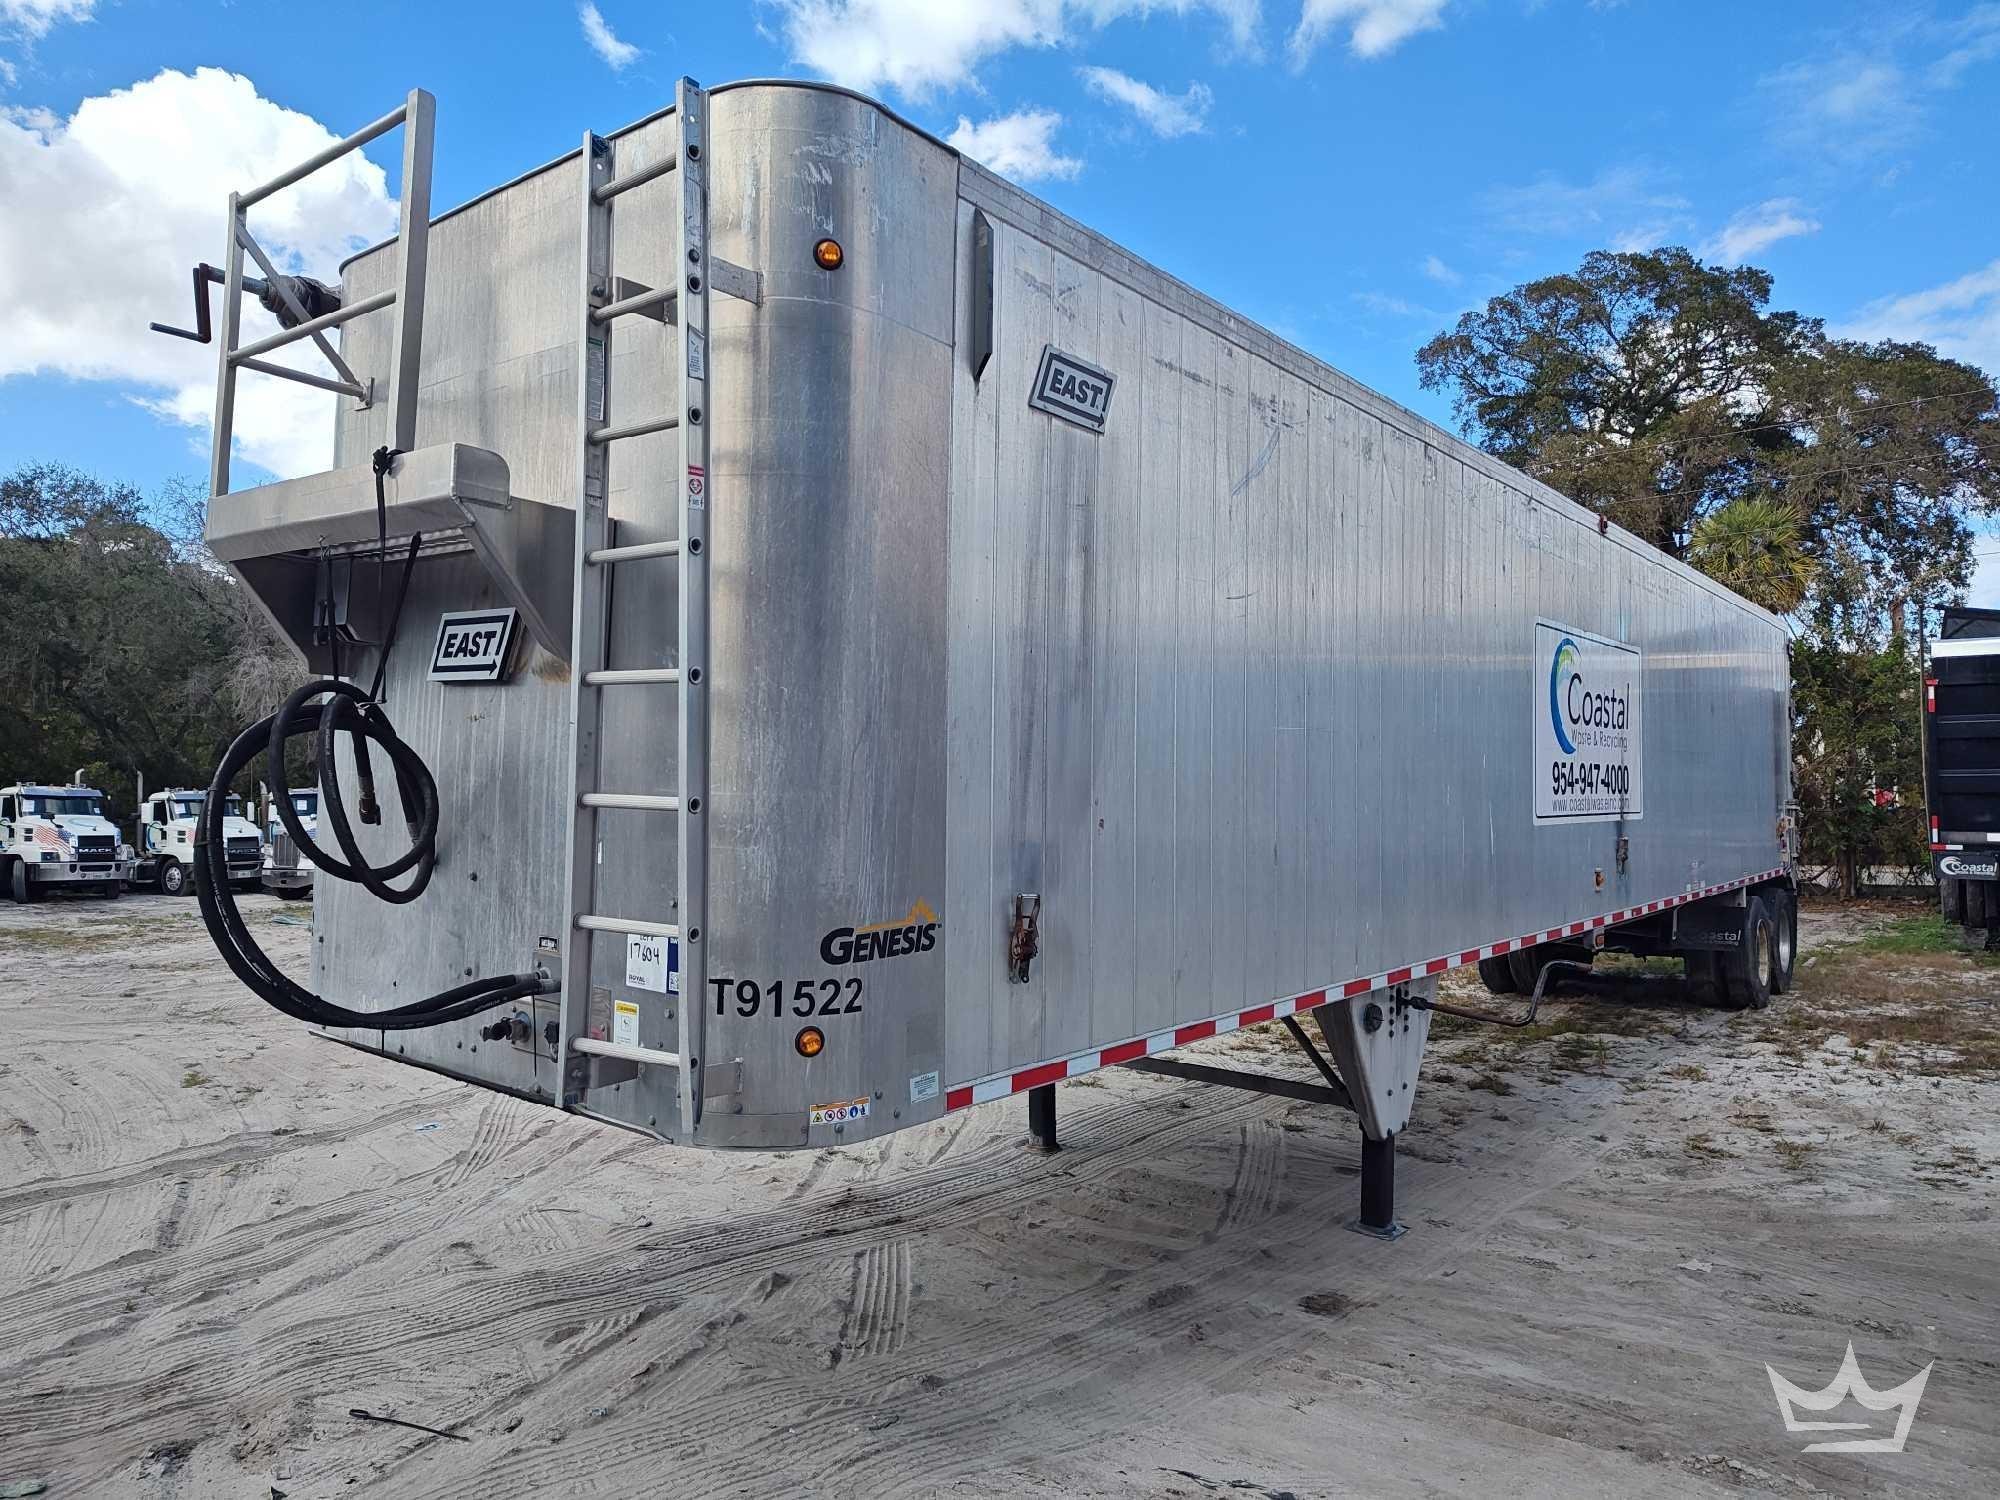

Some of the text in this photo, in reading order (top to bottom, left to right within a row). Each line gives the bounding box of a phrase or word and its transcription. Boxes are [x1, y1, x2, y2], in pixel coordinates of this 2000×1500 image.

[1049, 367, 1104, 409] EAST
[443, 630, 498, 658] EAST
[1567, 672, 1630, 730] Coastal
[1571, 728, 1592, 746] Waste
[1593, 731, 1598, 746] &
[1552, 761, 1630, 796] 954-947-4000
[1946, 860, 1998, 874] Coastal
[630, 942, 660, 966] 17604
[820, 923, 937, 965] GENESIS
[708, 978, 863, 1018] T91522
